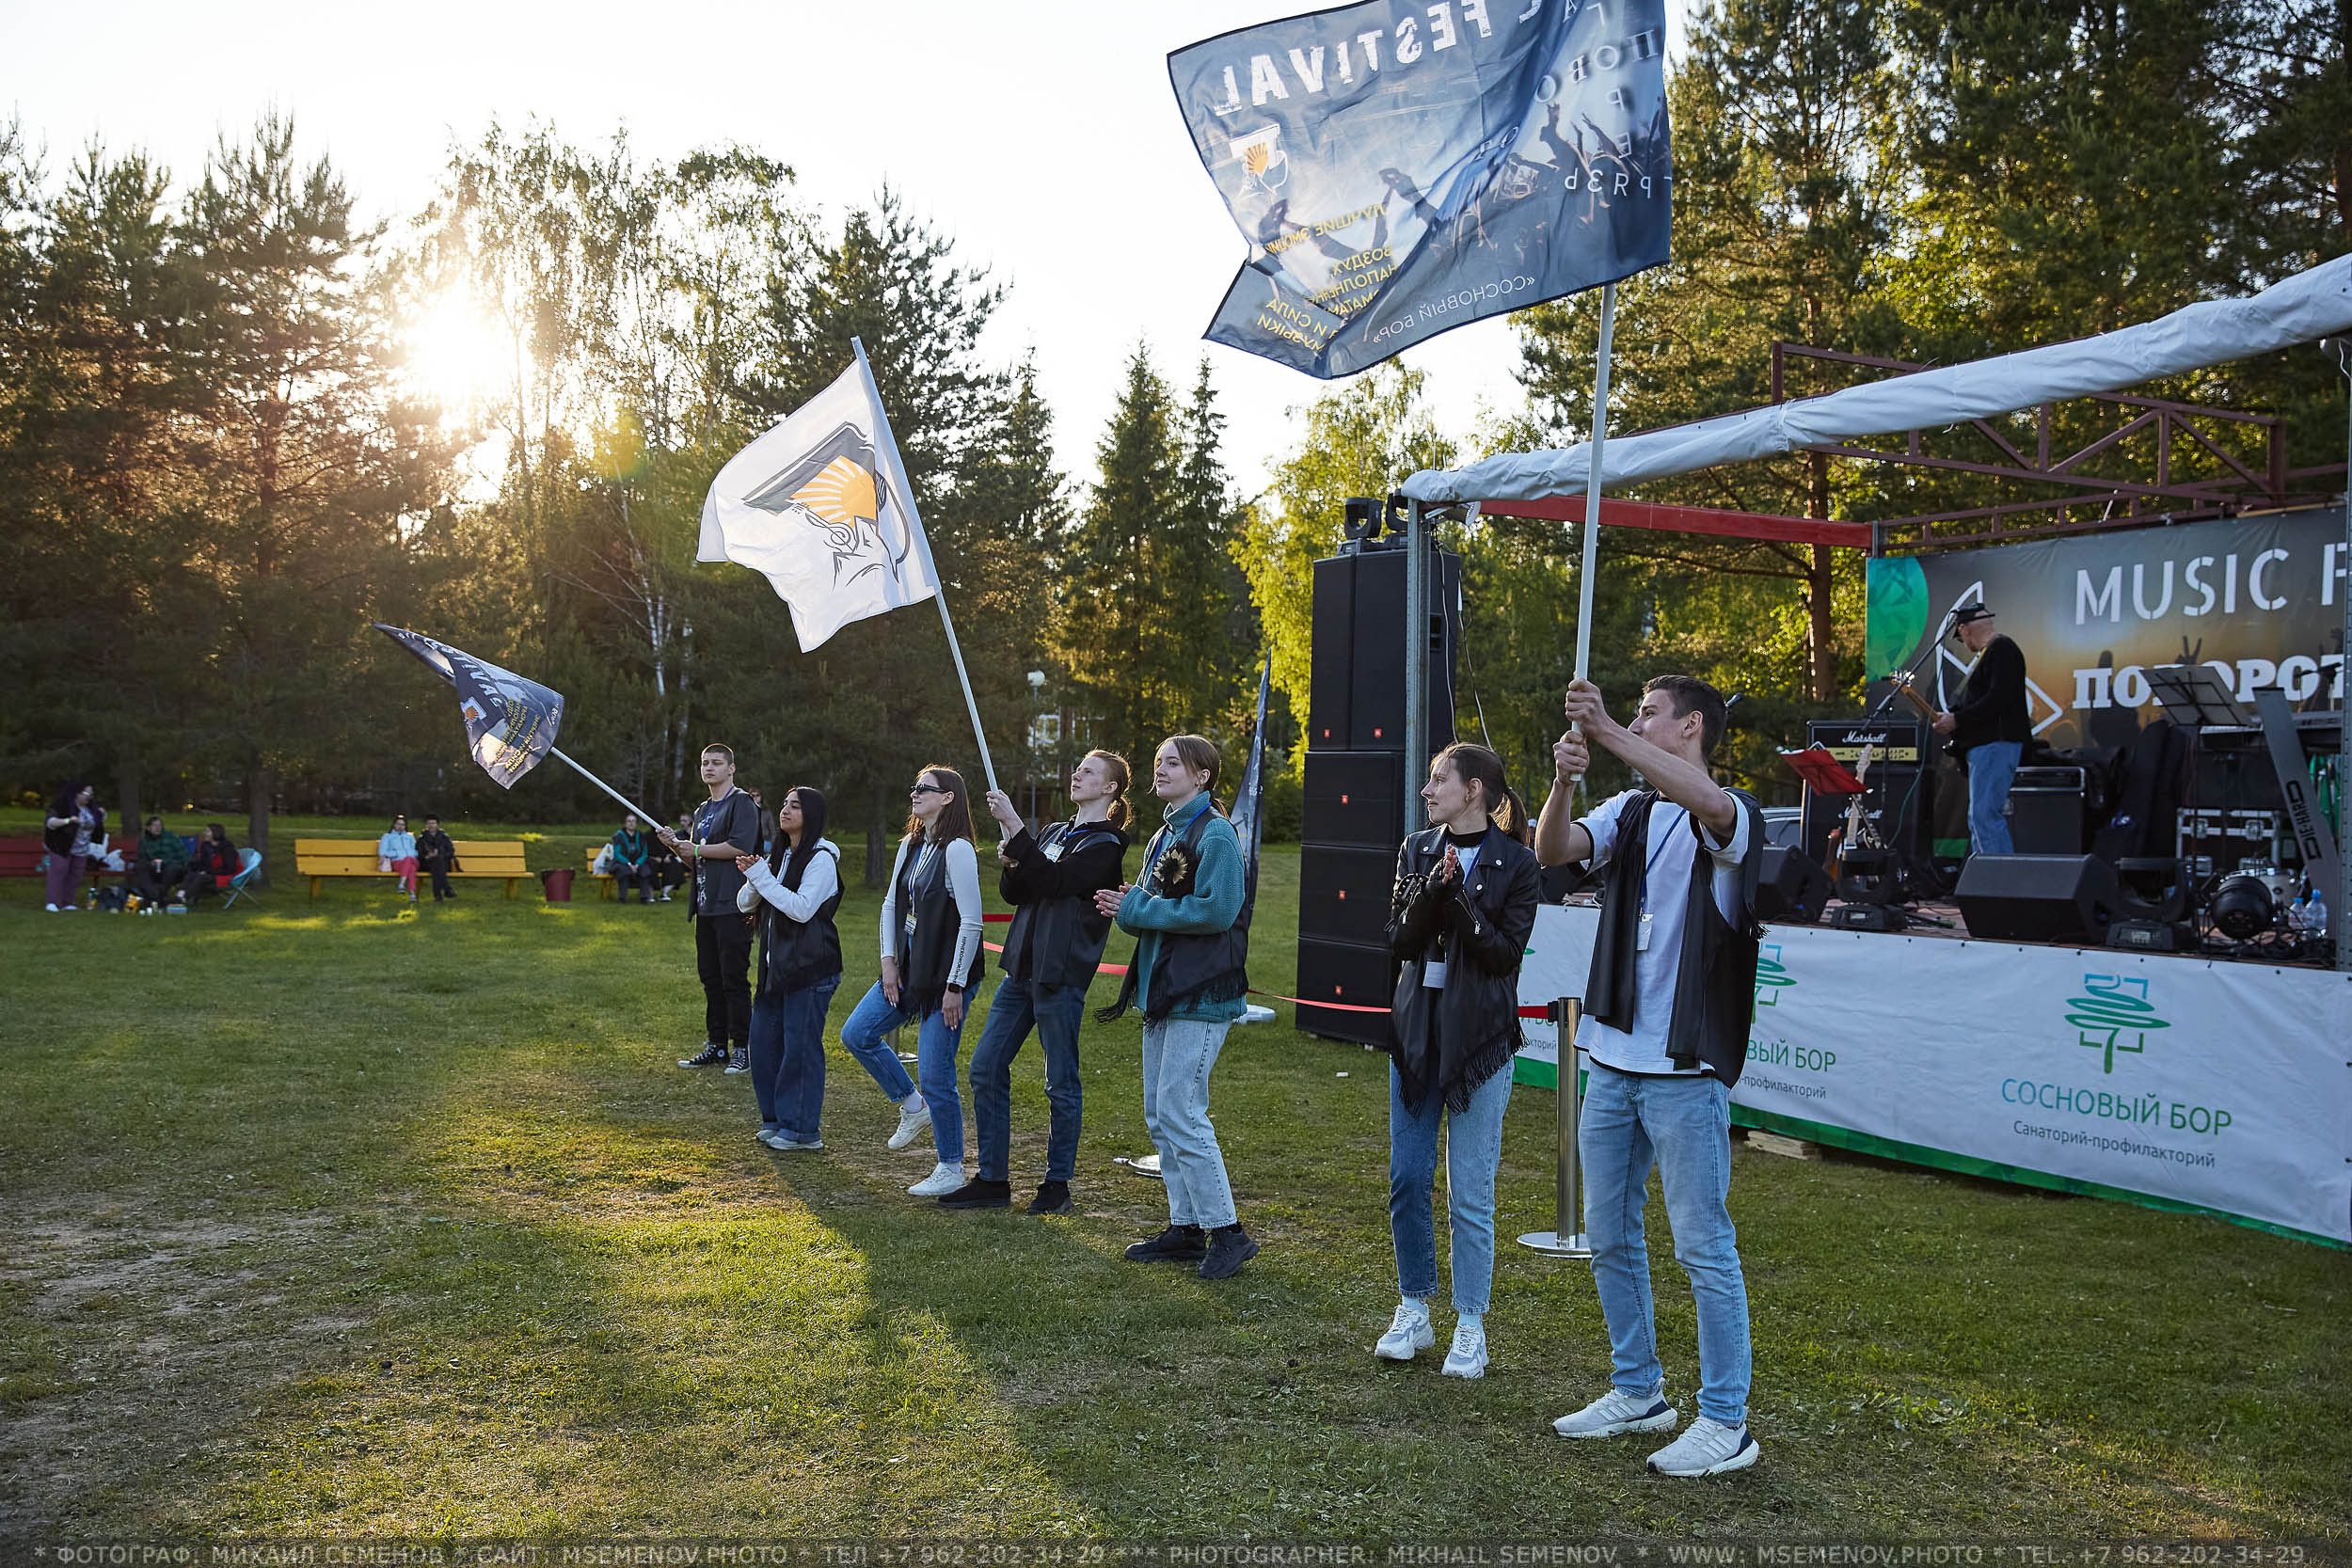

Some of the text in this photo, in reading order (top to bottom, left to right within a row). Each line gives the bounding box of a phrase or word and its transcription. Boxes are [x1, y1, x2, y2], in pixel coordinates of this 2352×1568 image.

[2075, 548, 2290, 626] MUSIC
[1842, 730, 1887, 743] Marshall
[1795, 1046, 1837, 1072] БОР
[2001, 1078, 2233, 1136] СОСНОВЫЙ БОР
[2013, 1119, 2216, 1168] Санаторий-профилакторий
